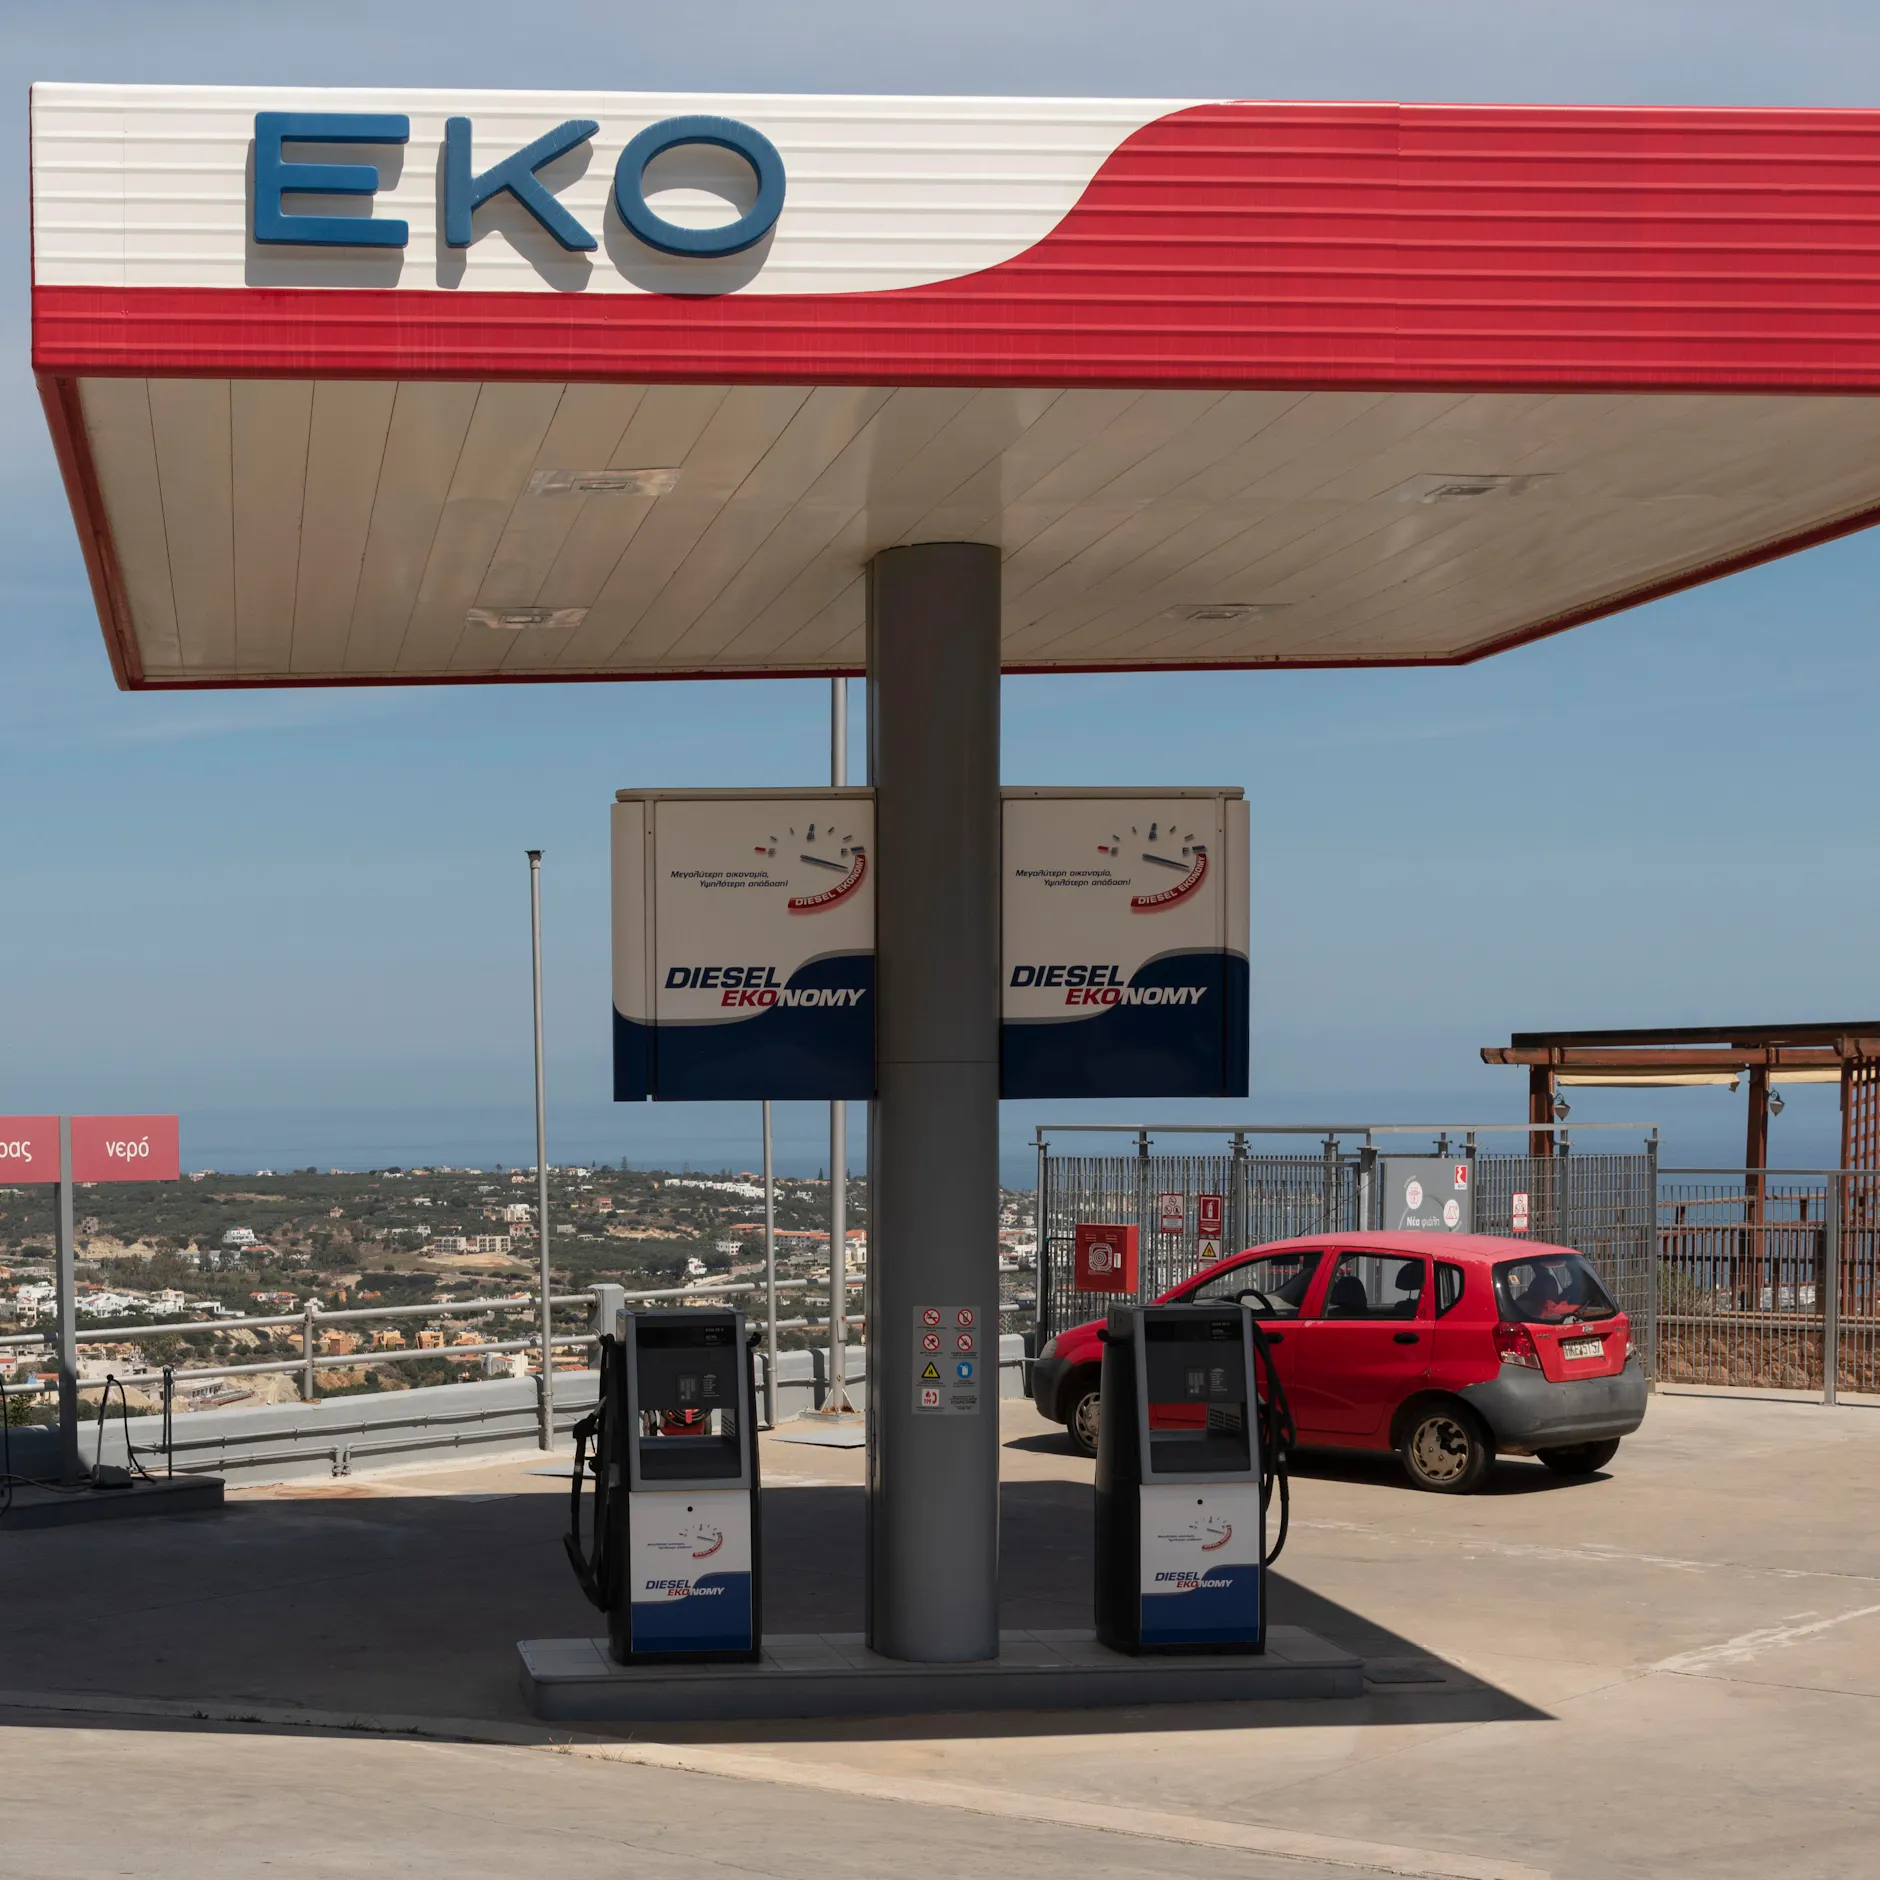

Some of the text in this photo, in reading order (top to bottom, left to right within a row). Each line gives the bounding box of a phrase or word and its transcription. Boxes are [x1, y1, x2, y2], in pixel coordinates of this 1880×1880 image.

[253, 110, 787, 259] EKO
[670, 869, 723, 879] Μεγαλύτερη
[1015, 868, 1067, 878] Μεγαλύτερη
[700, 879, 788, 888] Υψηλότερη απόδοση!
[796, 857, 865, 906] DIESEL EKONOMY
[1044, 878, 1131, 887] Υψηλότερη απόδοση!
[1139, 856, 1206, 905] DIESEL EKONOMY
[664, 966, 781, 989] DIESEL
[1009, 965, 1125, 988] DIESEL
[720, 988, 867, 1007] EKONOMY
[1065, 987, 1208, 1006] EKONOMY
[105, 1135, 149, 1163] νερό
[1406, 1216, 1420, 1227] Νέα
[1154, 1571, 1200, 1582] DIESEL
[645, 1579, 691, 1590] DIESEL
[1176, 1579, 1234, 1589] EKONOMY
[667, 1587, 725, 1597] EKONOMY
